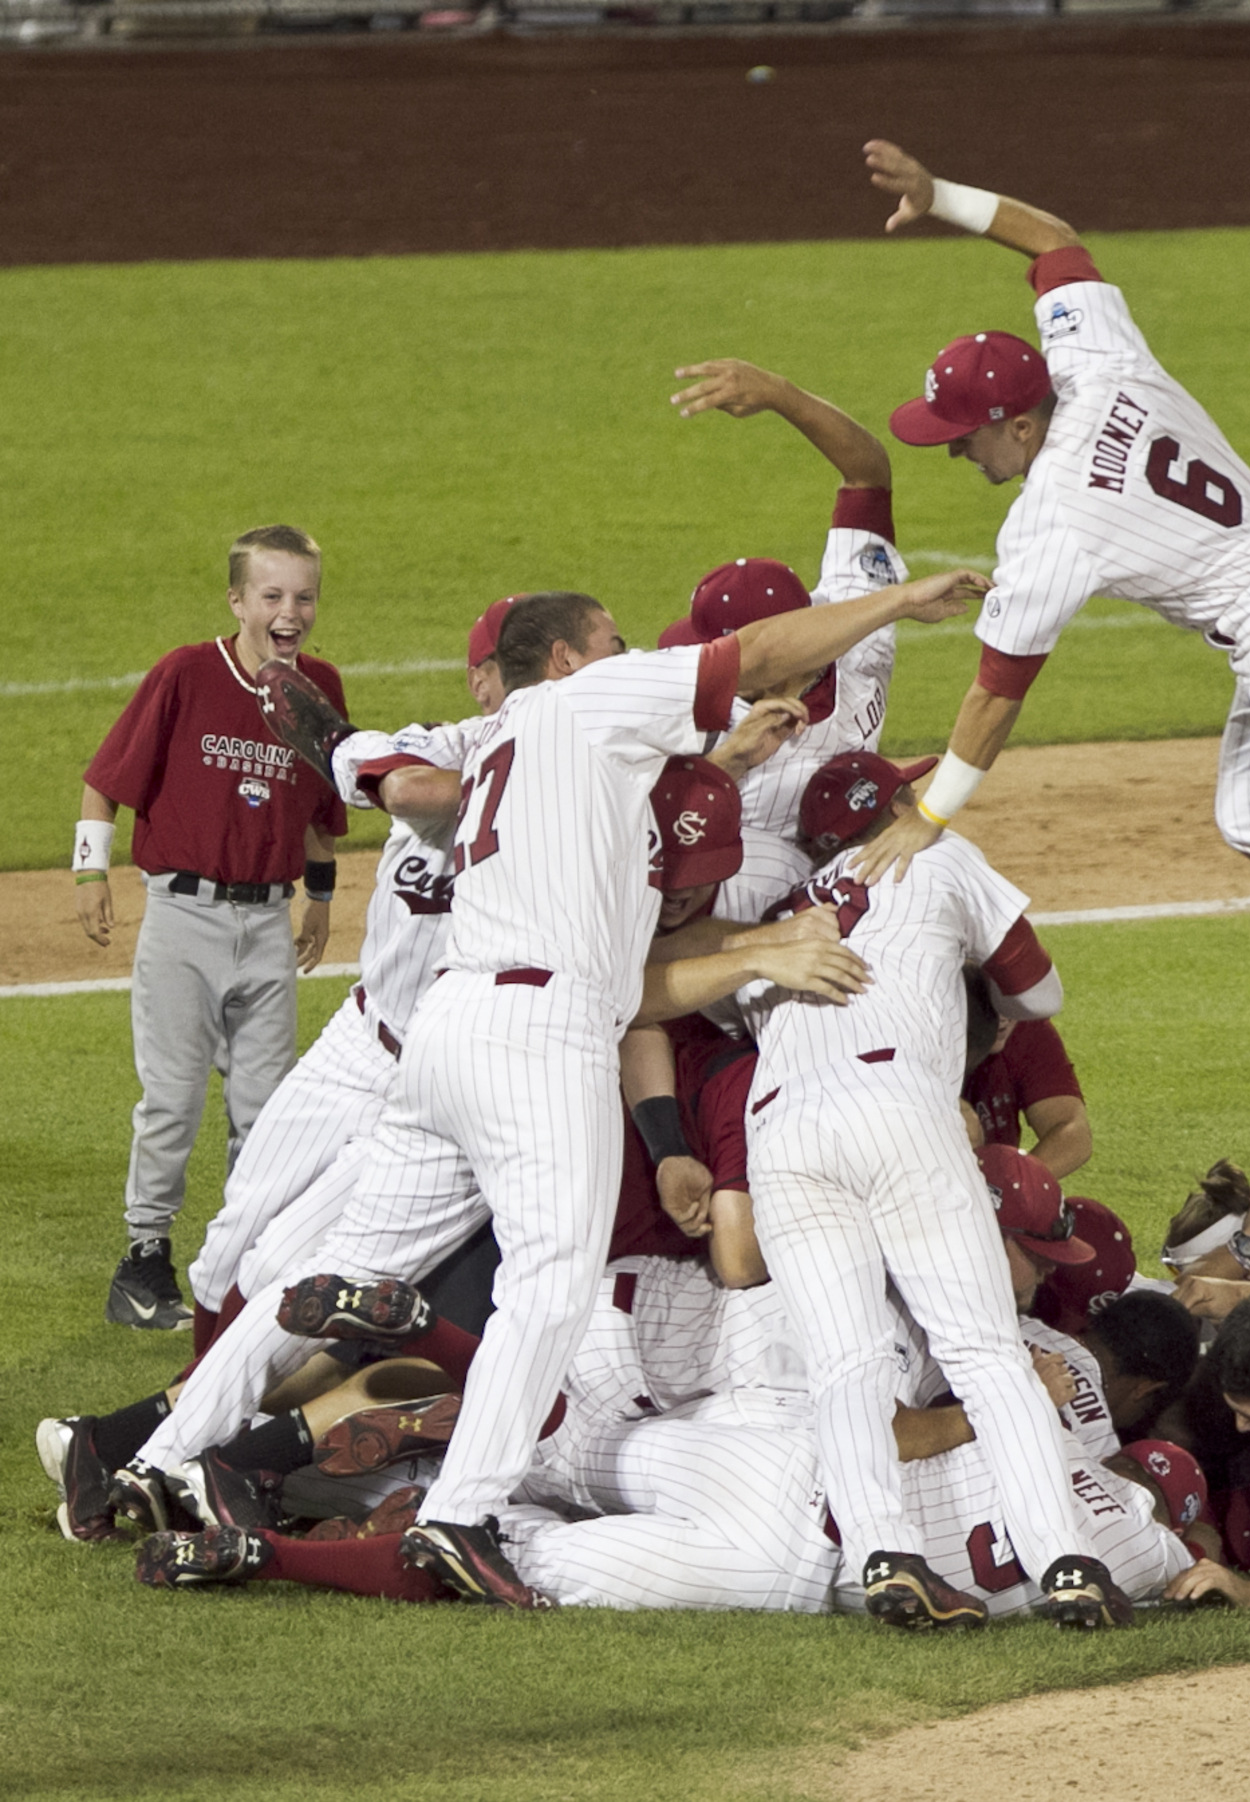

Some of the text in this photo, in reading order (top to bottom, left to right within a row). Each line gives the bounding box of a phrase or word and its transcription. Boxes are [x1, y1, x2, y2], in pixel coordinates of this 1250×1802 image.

[1088, 391, 1148, 494] MOONEY
[1145, 435, 1242, 529] 6
[1071, 1469, 1127, 1516] NEFF
